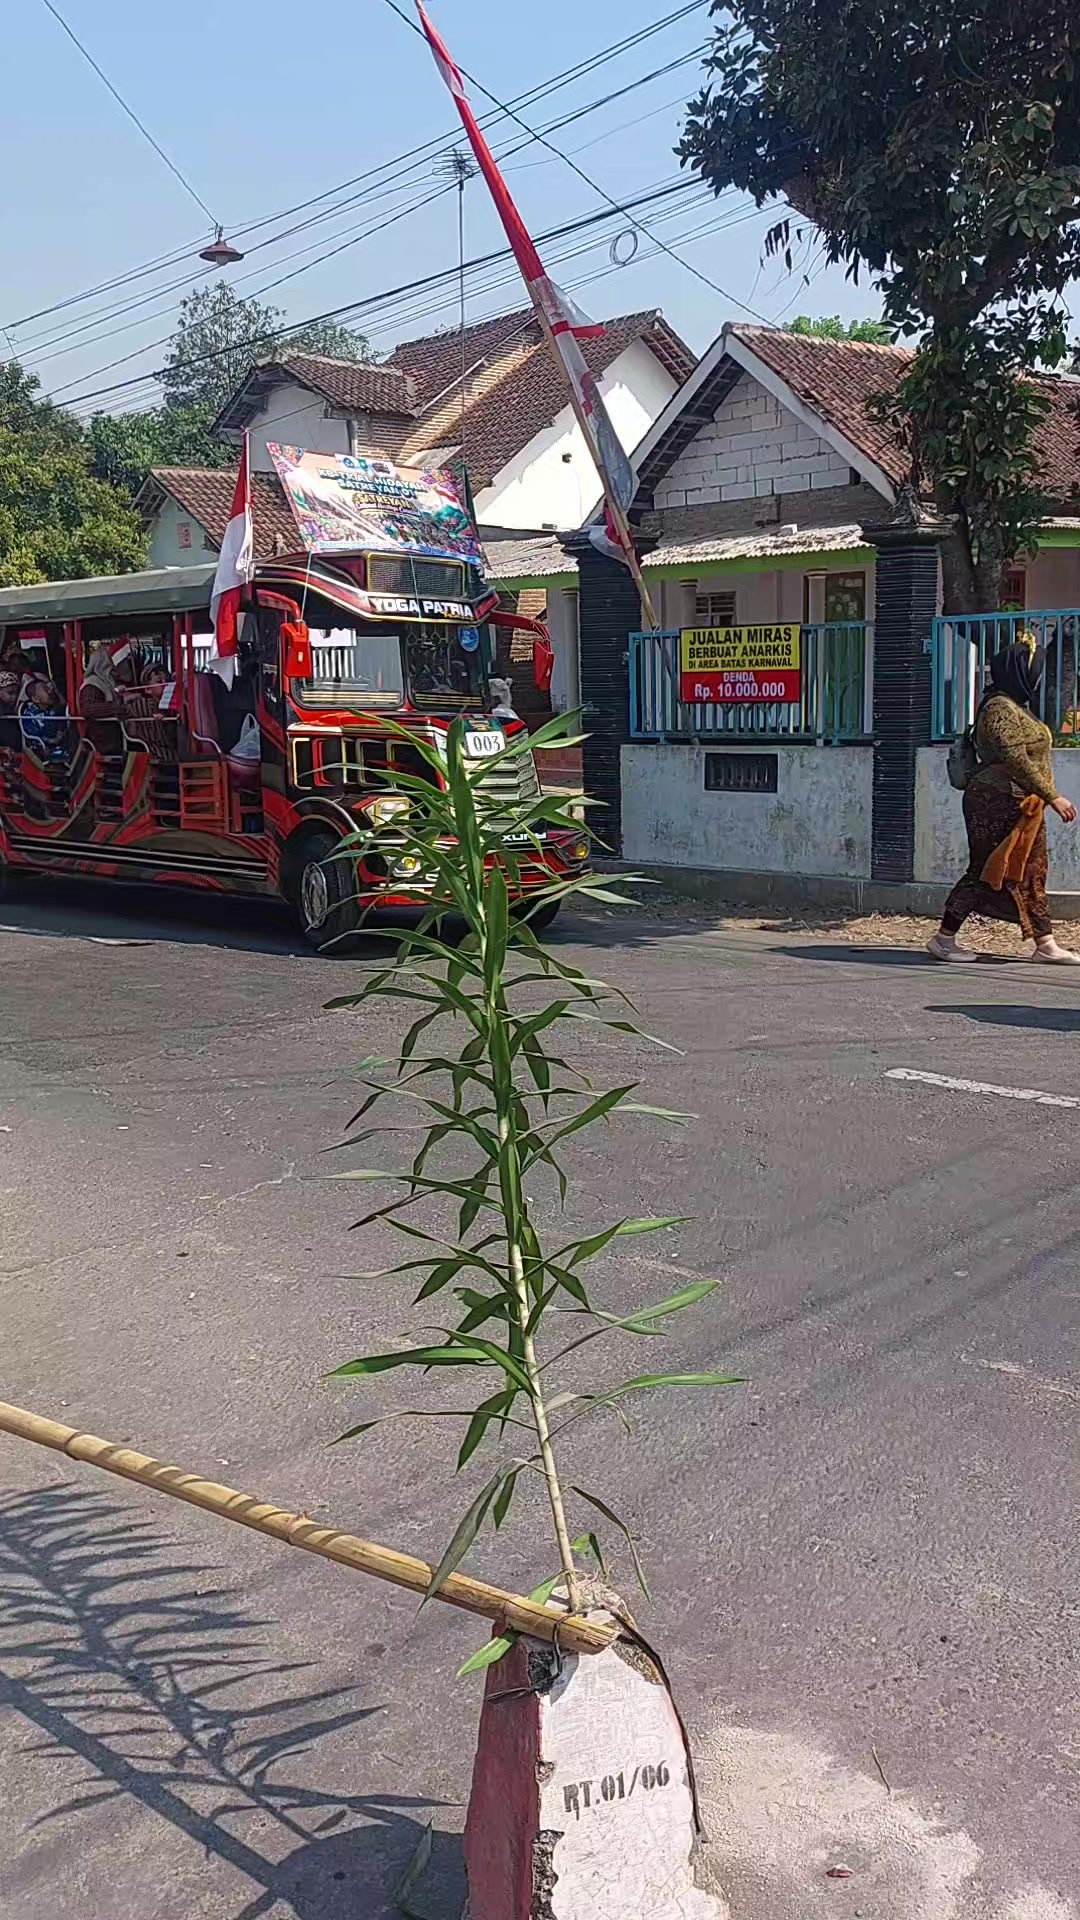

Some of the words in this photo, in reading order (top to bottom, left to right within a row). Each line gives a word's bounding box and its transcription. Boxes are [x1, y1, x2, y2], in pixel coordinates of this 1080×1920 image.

[337, 479, 400, 495] SATREYAN
[373, 476, 425, 490] HIDAYAH
[357, 493, 411, 509] SATREYAN
[369, 598, 420, 613] YOGA
[422, 600, 475, 618] PATRIA
[689, 629, 742, 645] JUALAN
[747, 627, 792, 644] MIRAS
[688, 645, 738, 659] BERBUAT
[741, 644, 792, 658] ANARKIS
[688, 660, 696, 669] DI
[698, 659, 719, 669] AREA
[720, 658, 746, 668] BATAS
[748, 657, 793, 667] KARNAVAL
[723, 671, 756, 682] DENDA
[694, 683, 714, 700] Rp.
[717, 682, 786, 697] 10.000.000
[473, 735, 501, 752] 003
